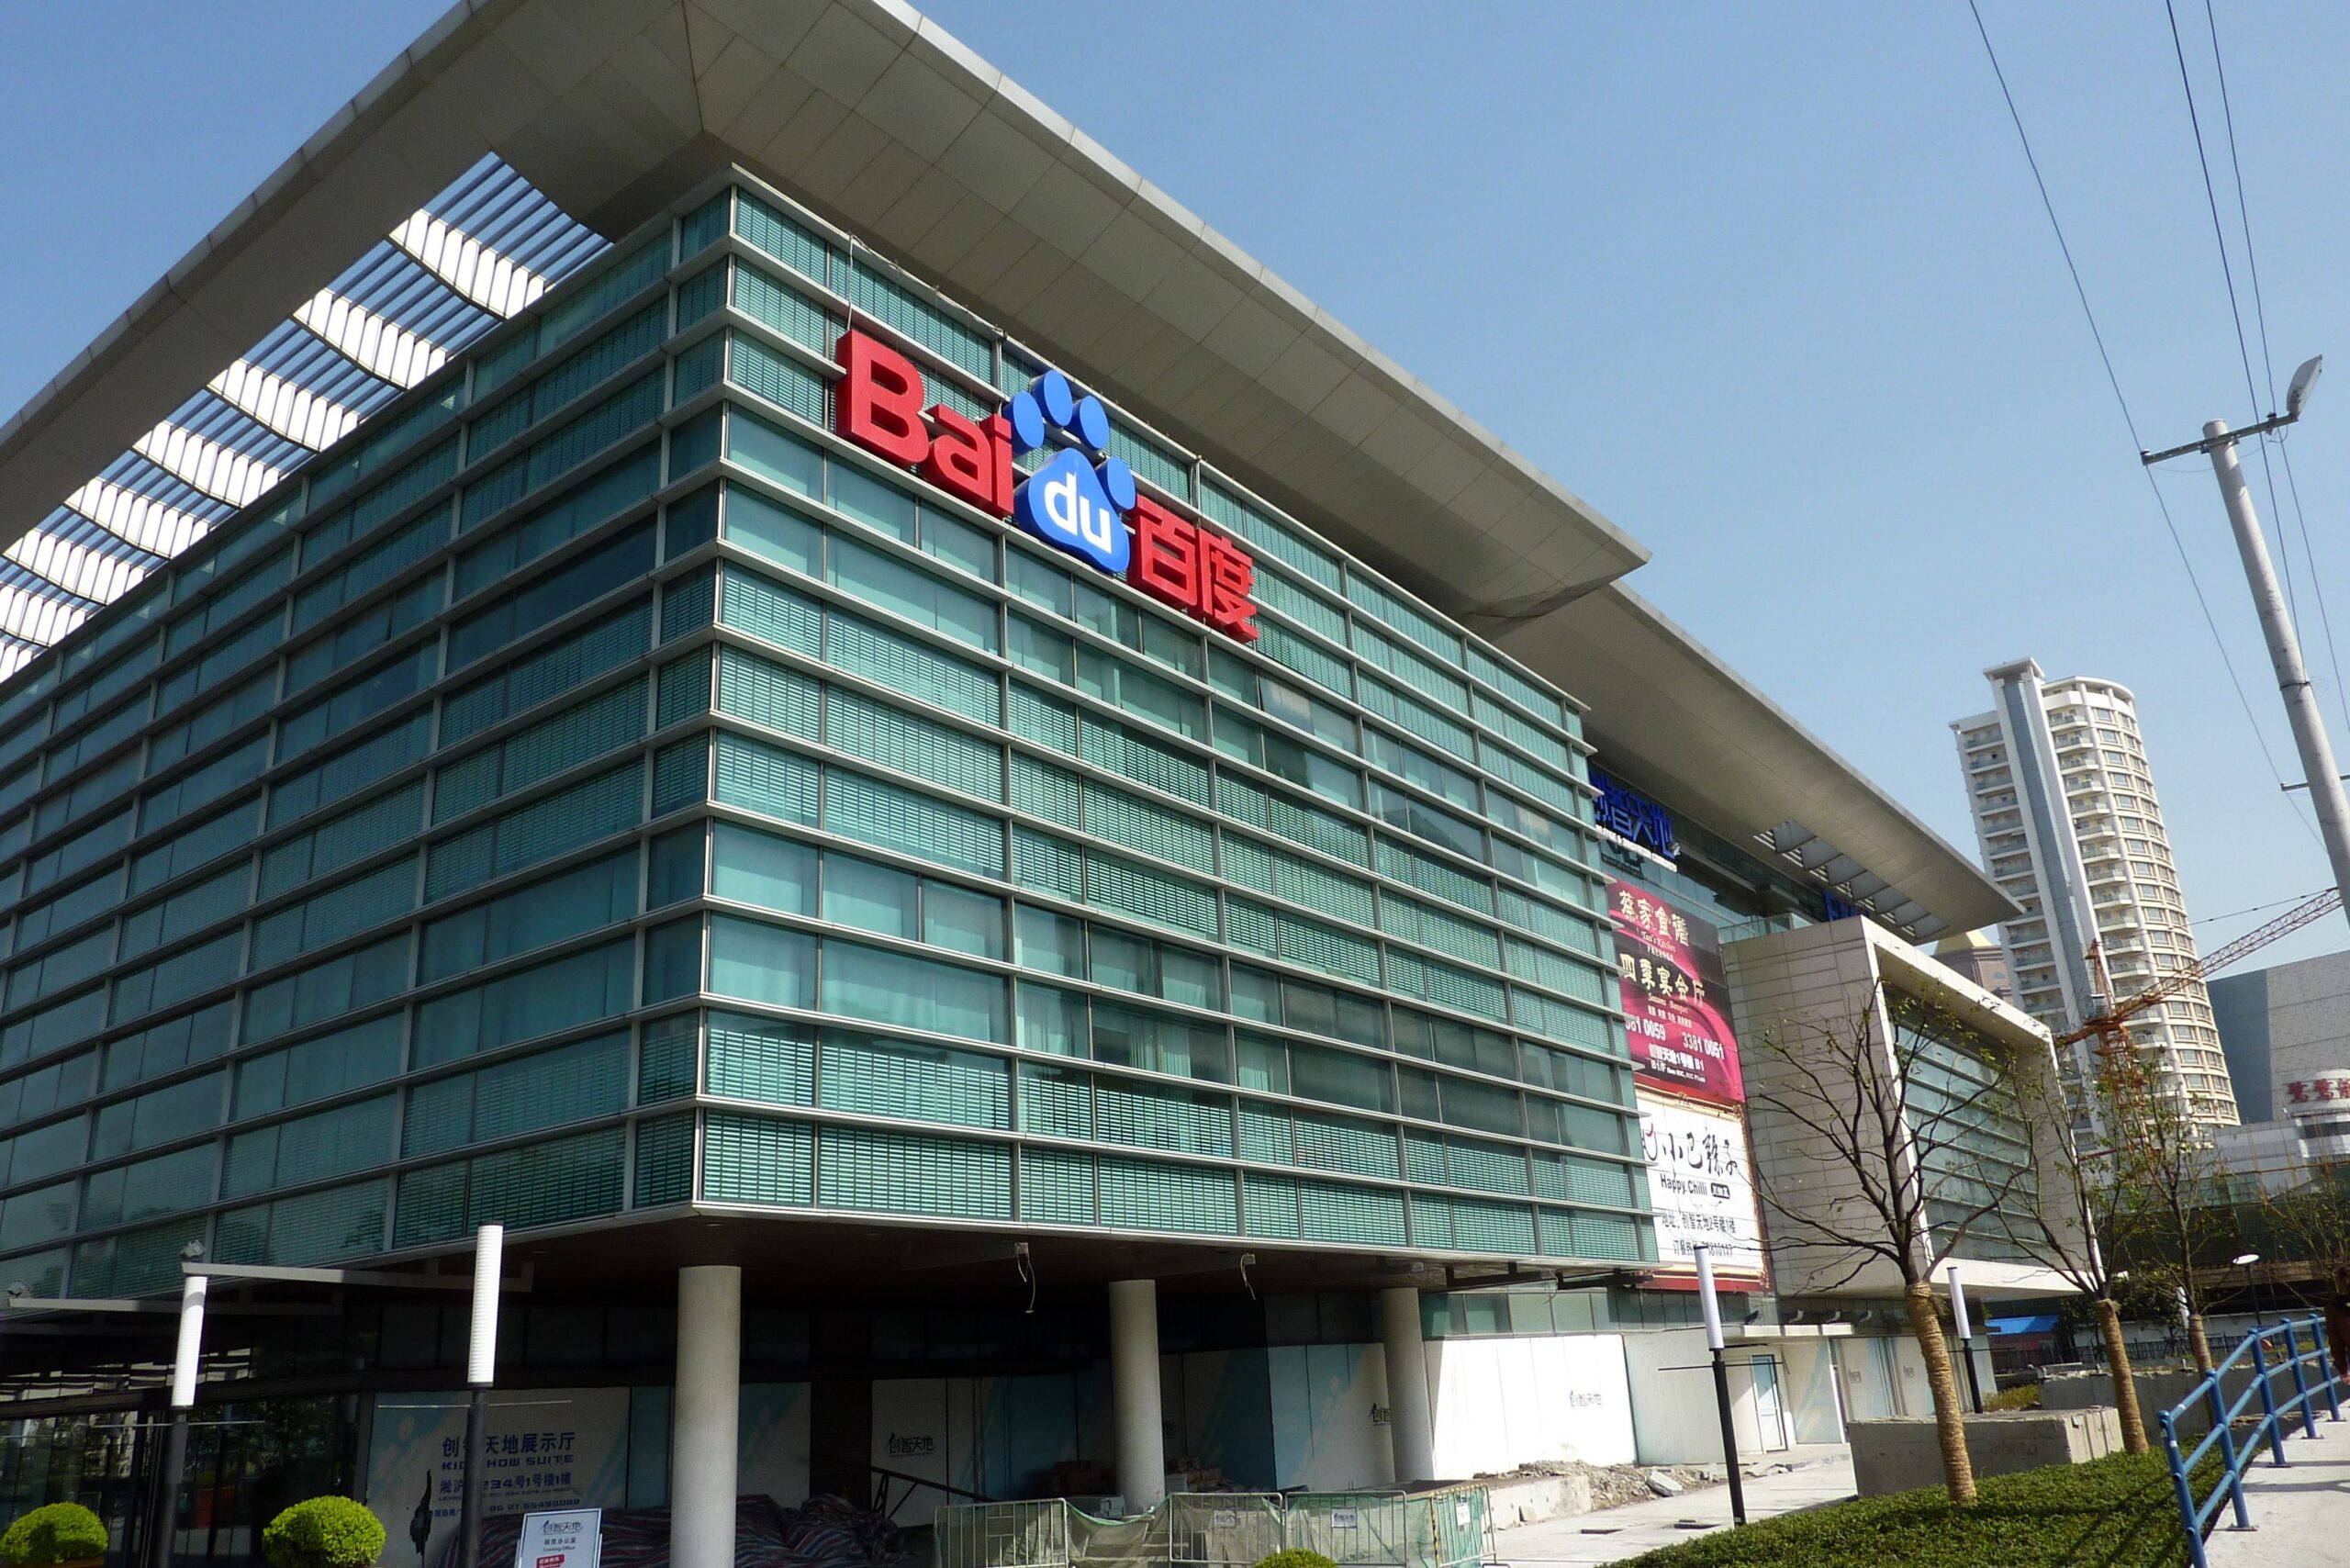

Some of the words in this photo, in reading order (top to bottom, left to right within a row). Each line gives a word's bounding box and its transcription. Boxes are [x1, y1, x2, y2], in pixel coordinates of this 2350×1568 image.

[1127, 494, 1259, 642] 百度
[1620, 953, 1705, 1007] 四季宴会厅
[1643, 1017, 1666, 1040] 0059
[1682, 1032, 1703, 1053] 3381
[1660, 1173, 1685, 1195] Happy
[1687, 1180, 1707, 1196] Chilli
[442, 1432, 576, 1457] 创天地展示厅
[885, 1432, 936, 1453] 创智天地
[486, 1458, 520, 1469] HOW
[526, 1454, 574, 1465] SUITE
